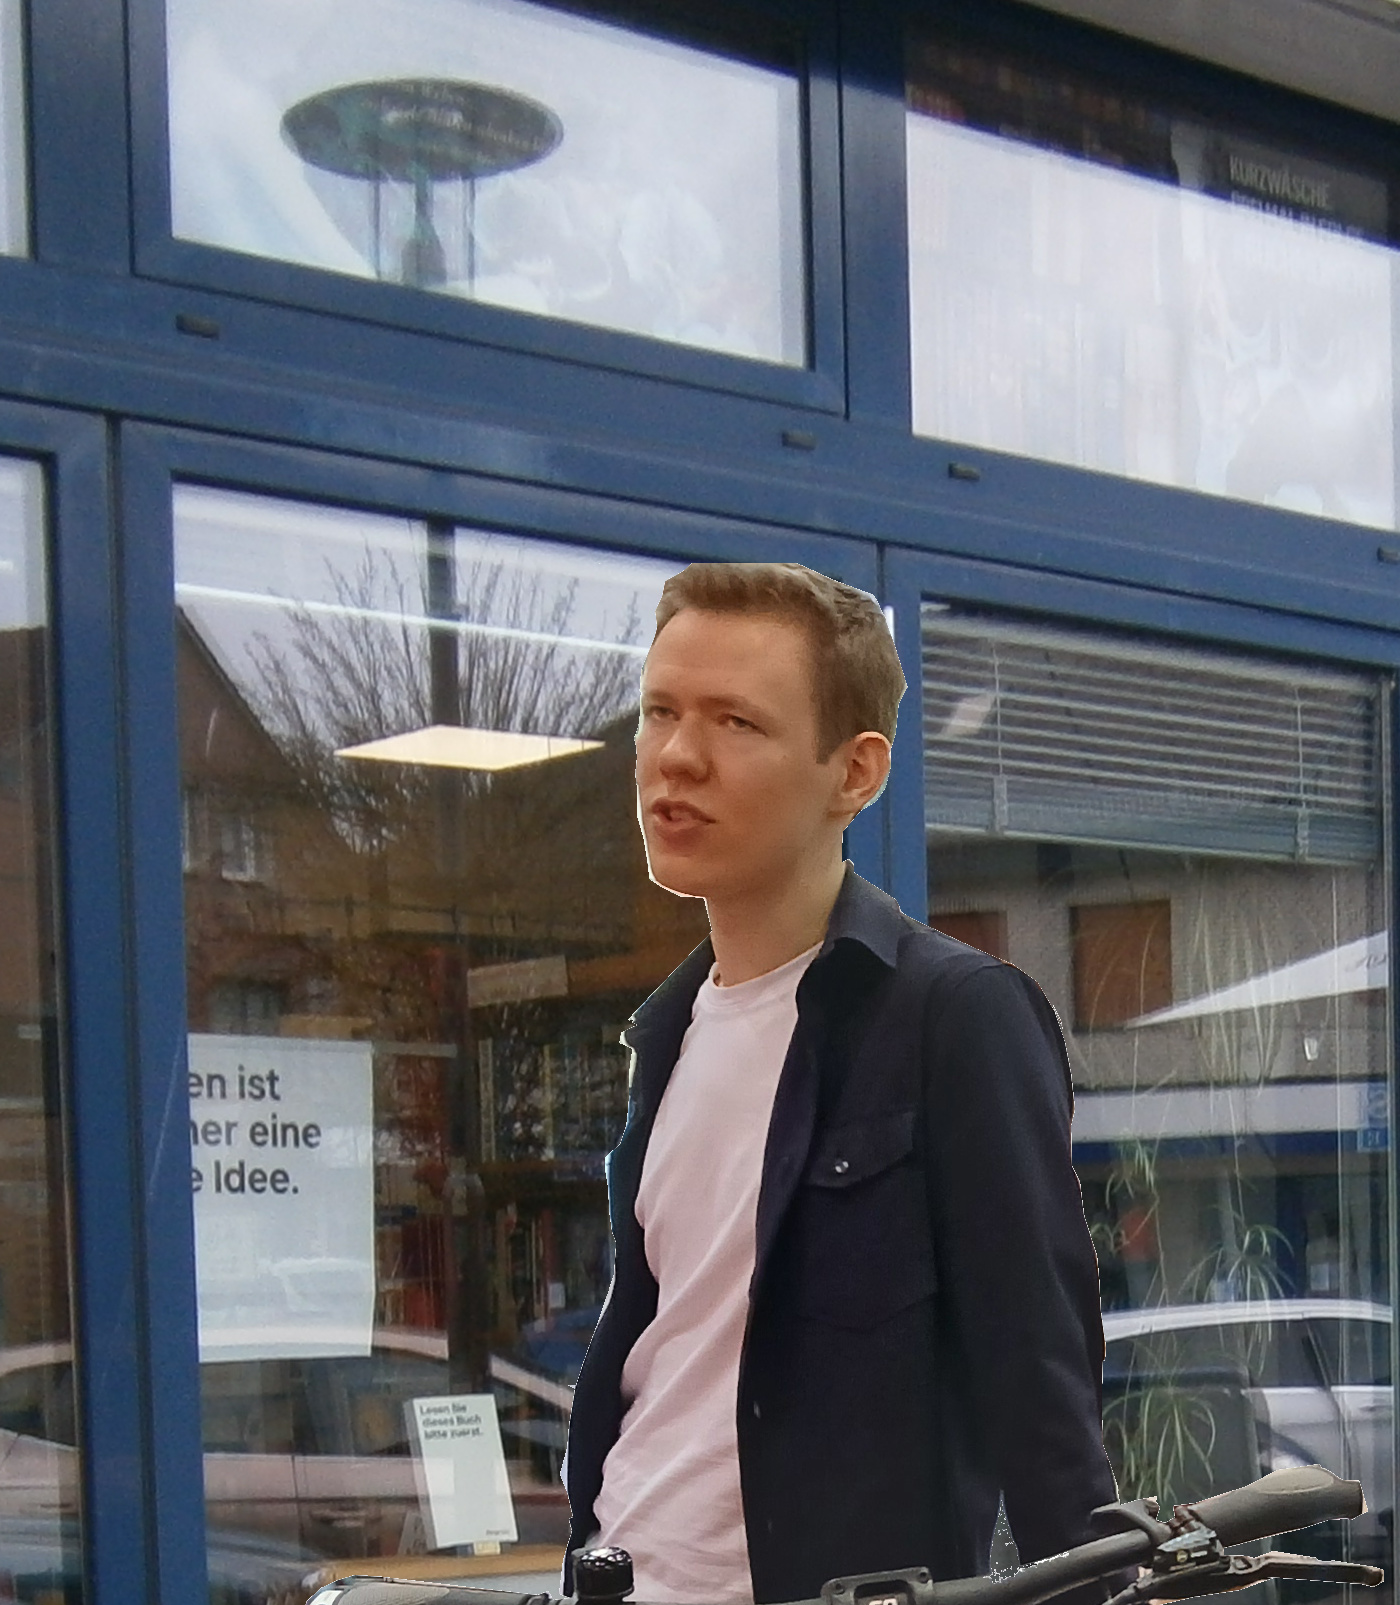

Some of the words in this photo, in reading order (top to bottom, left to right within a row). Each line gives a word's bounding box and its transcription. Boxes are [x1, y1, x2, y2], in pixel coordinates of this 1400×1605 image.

[237, 1063, 281, 1101] ist
[249, 1112, 322, 1149] eine
[214, 1159, 299, 1195] Idee.
